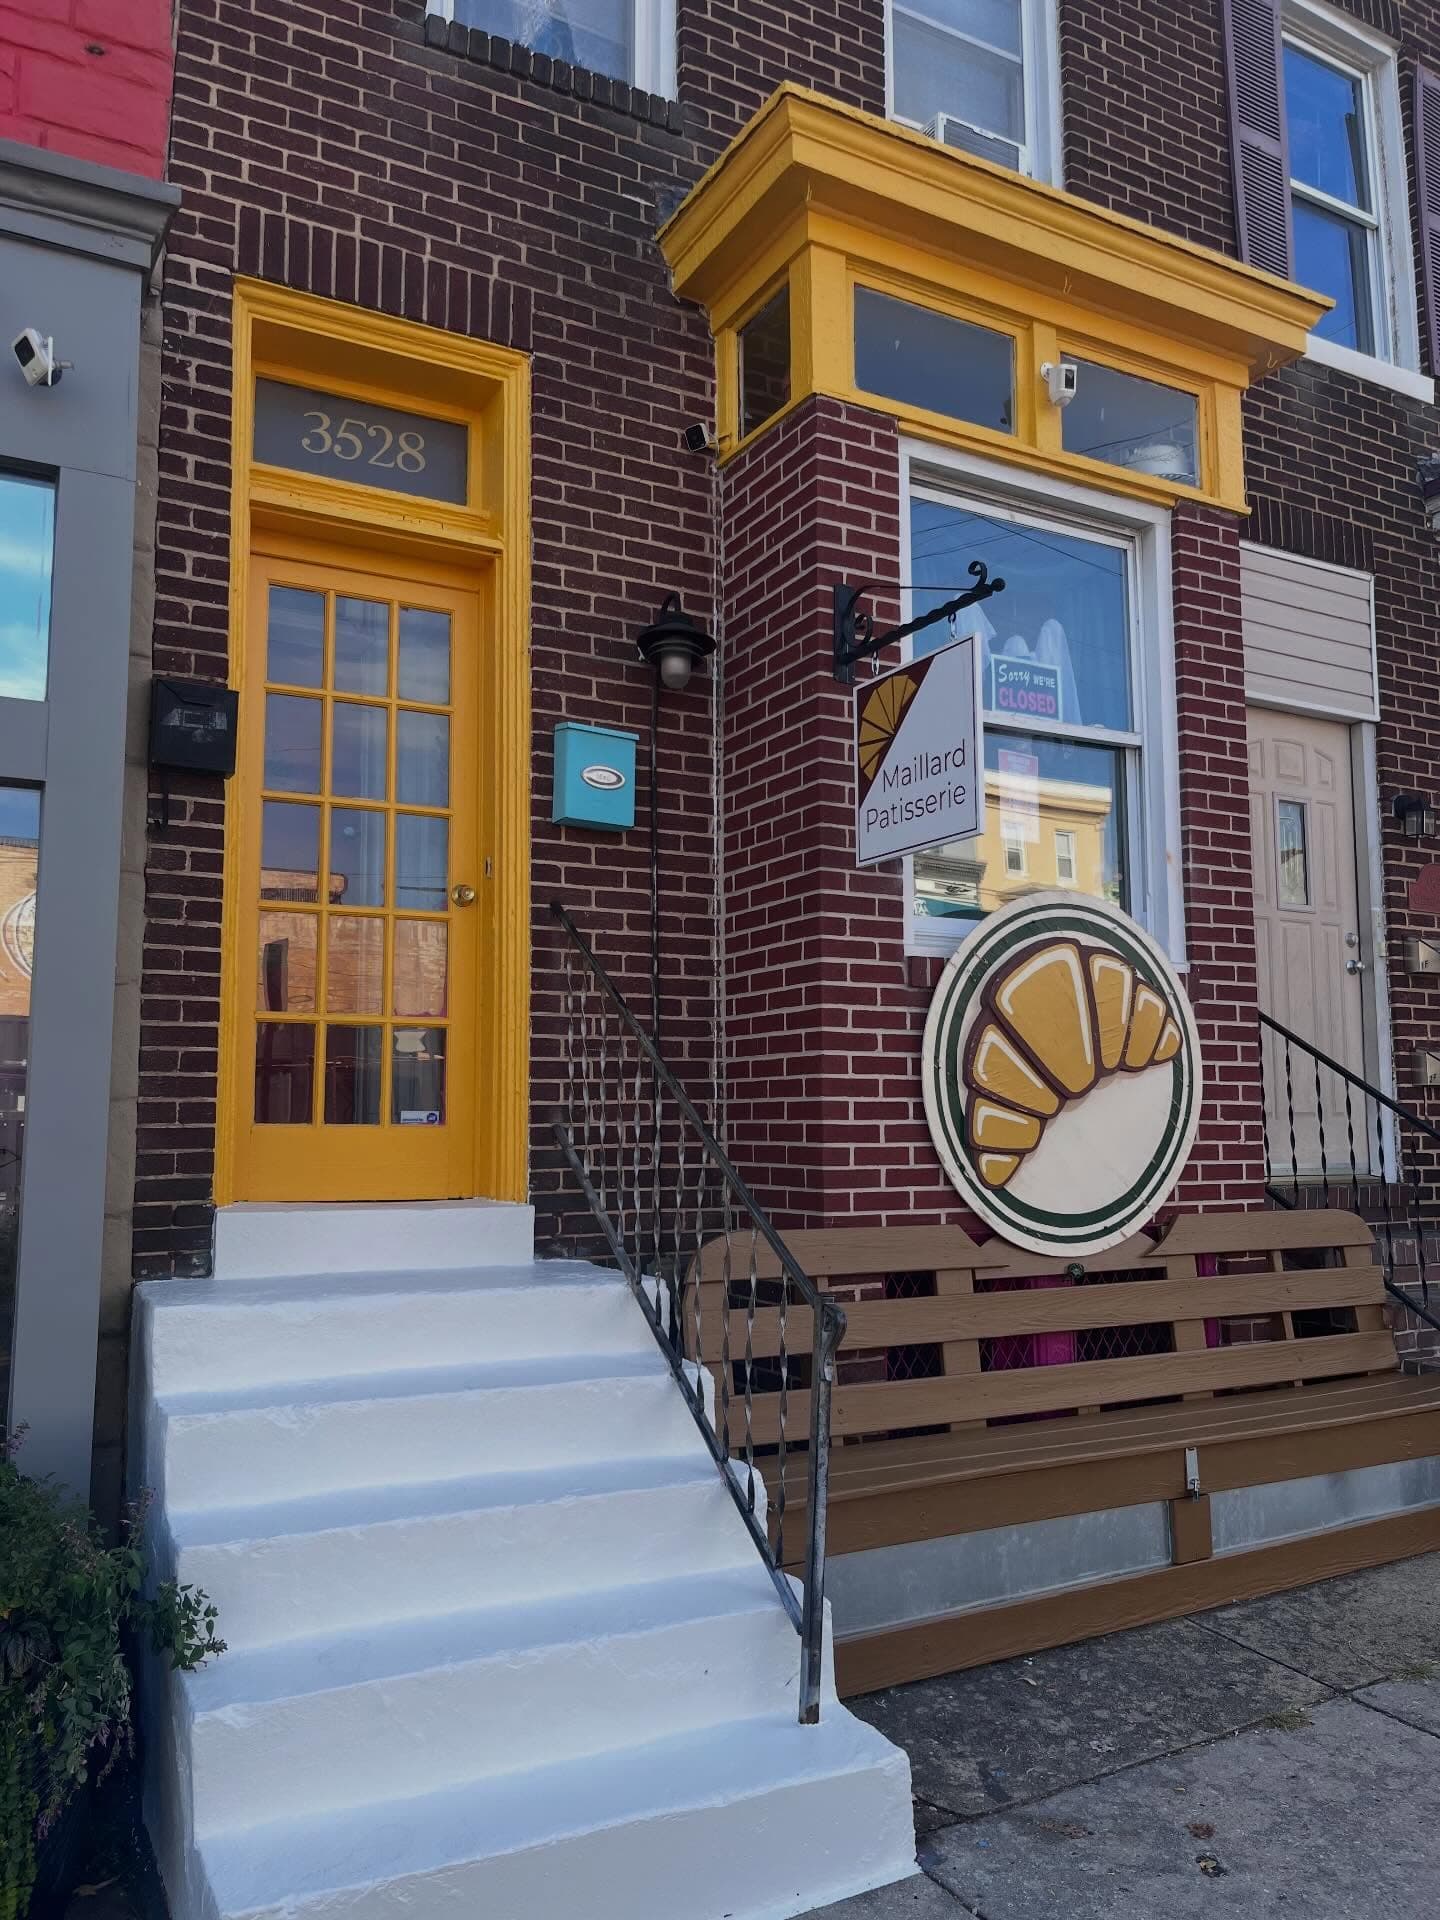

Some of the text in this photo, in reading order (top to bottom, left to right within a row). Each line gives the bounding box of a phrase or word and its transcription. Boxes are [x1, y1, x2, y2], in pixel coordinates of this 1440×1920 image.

[301, 411, 426, 473] 3528
[998, 663, 1056, 688] Sorry WE'RE
[998, 687, 1057, 714] CLOSED
[882, 738, 966, 793] Maillard
[866, 781, 966, 833] Patisserie
